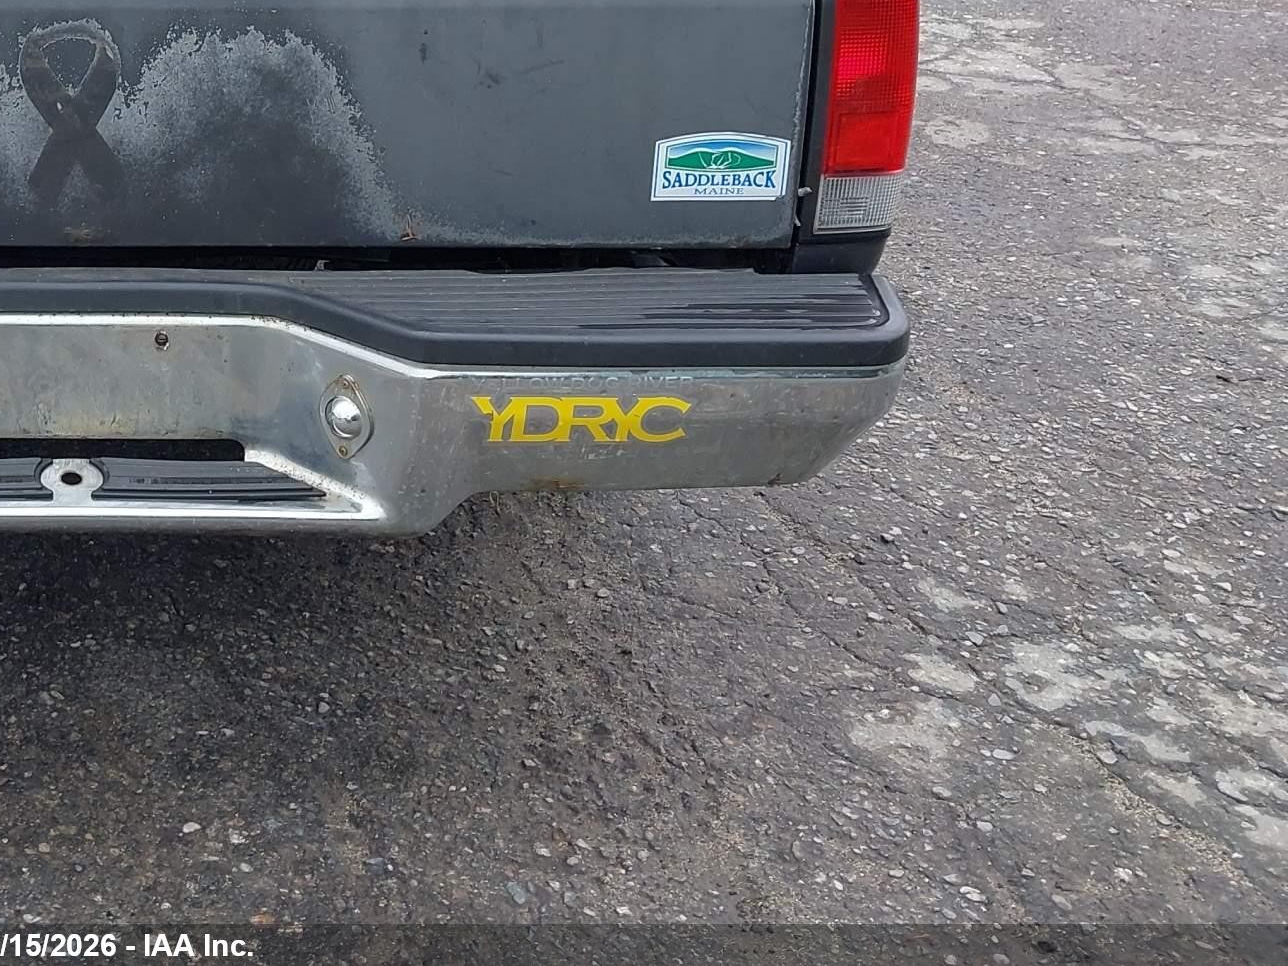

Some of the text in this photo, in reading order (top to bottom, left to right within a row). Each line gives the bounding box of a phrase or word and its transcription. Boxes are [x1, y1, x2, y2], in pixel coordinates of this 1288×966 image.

[662, 169, 777, 189] SADDLEBACK
[694, 187, 745, 195] MAINE
[471, 396, 691, 443] YDRYC
